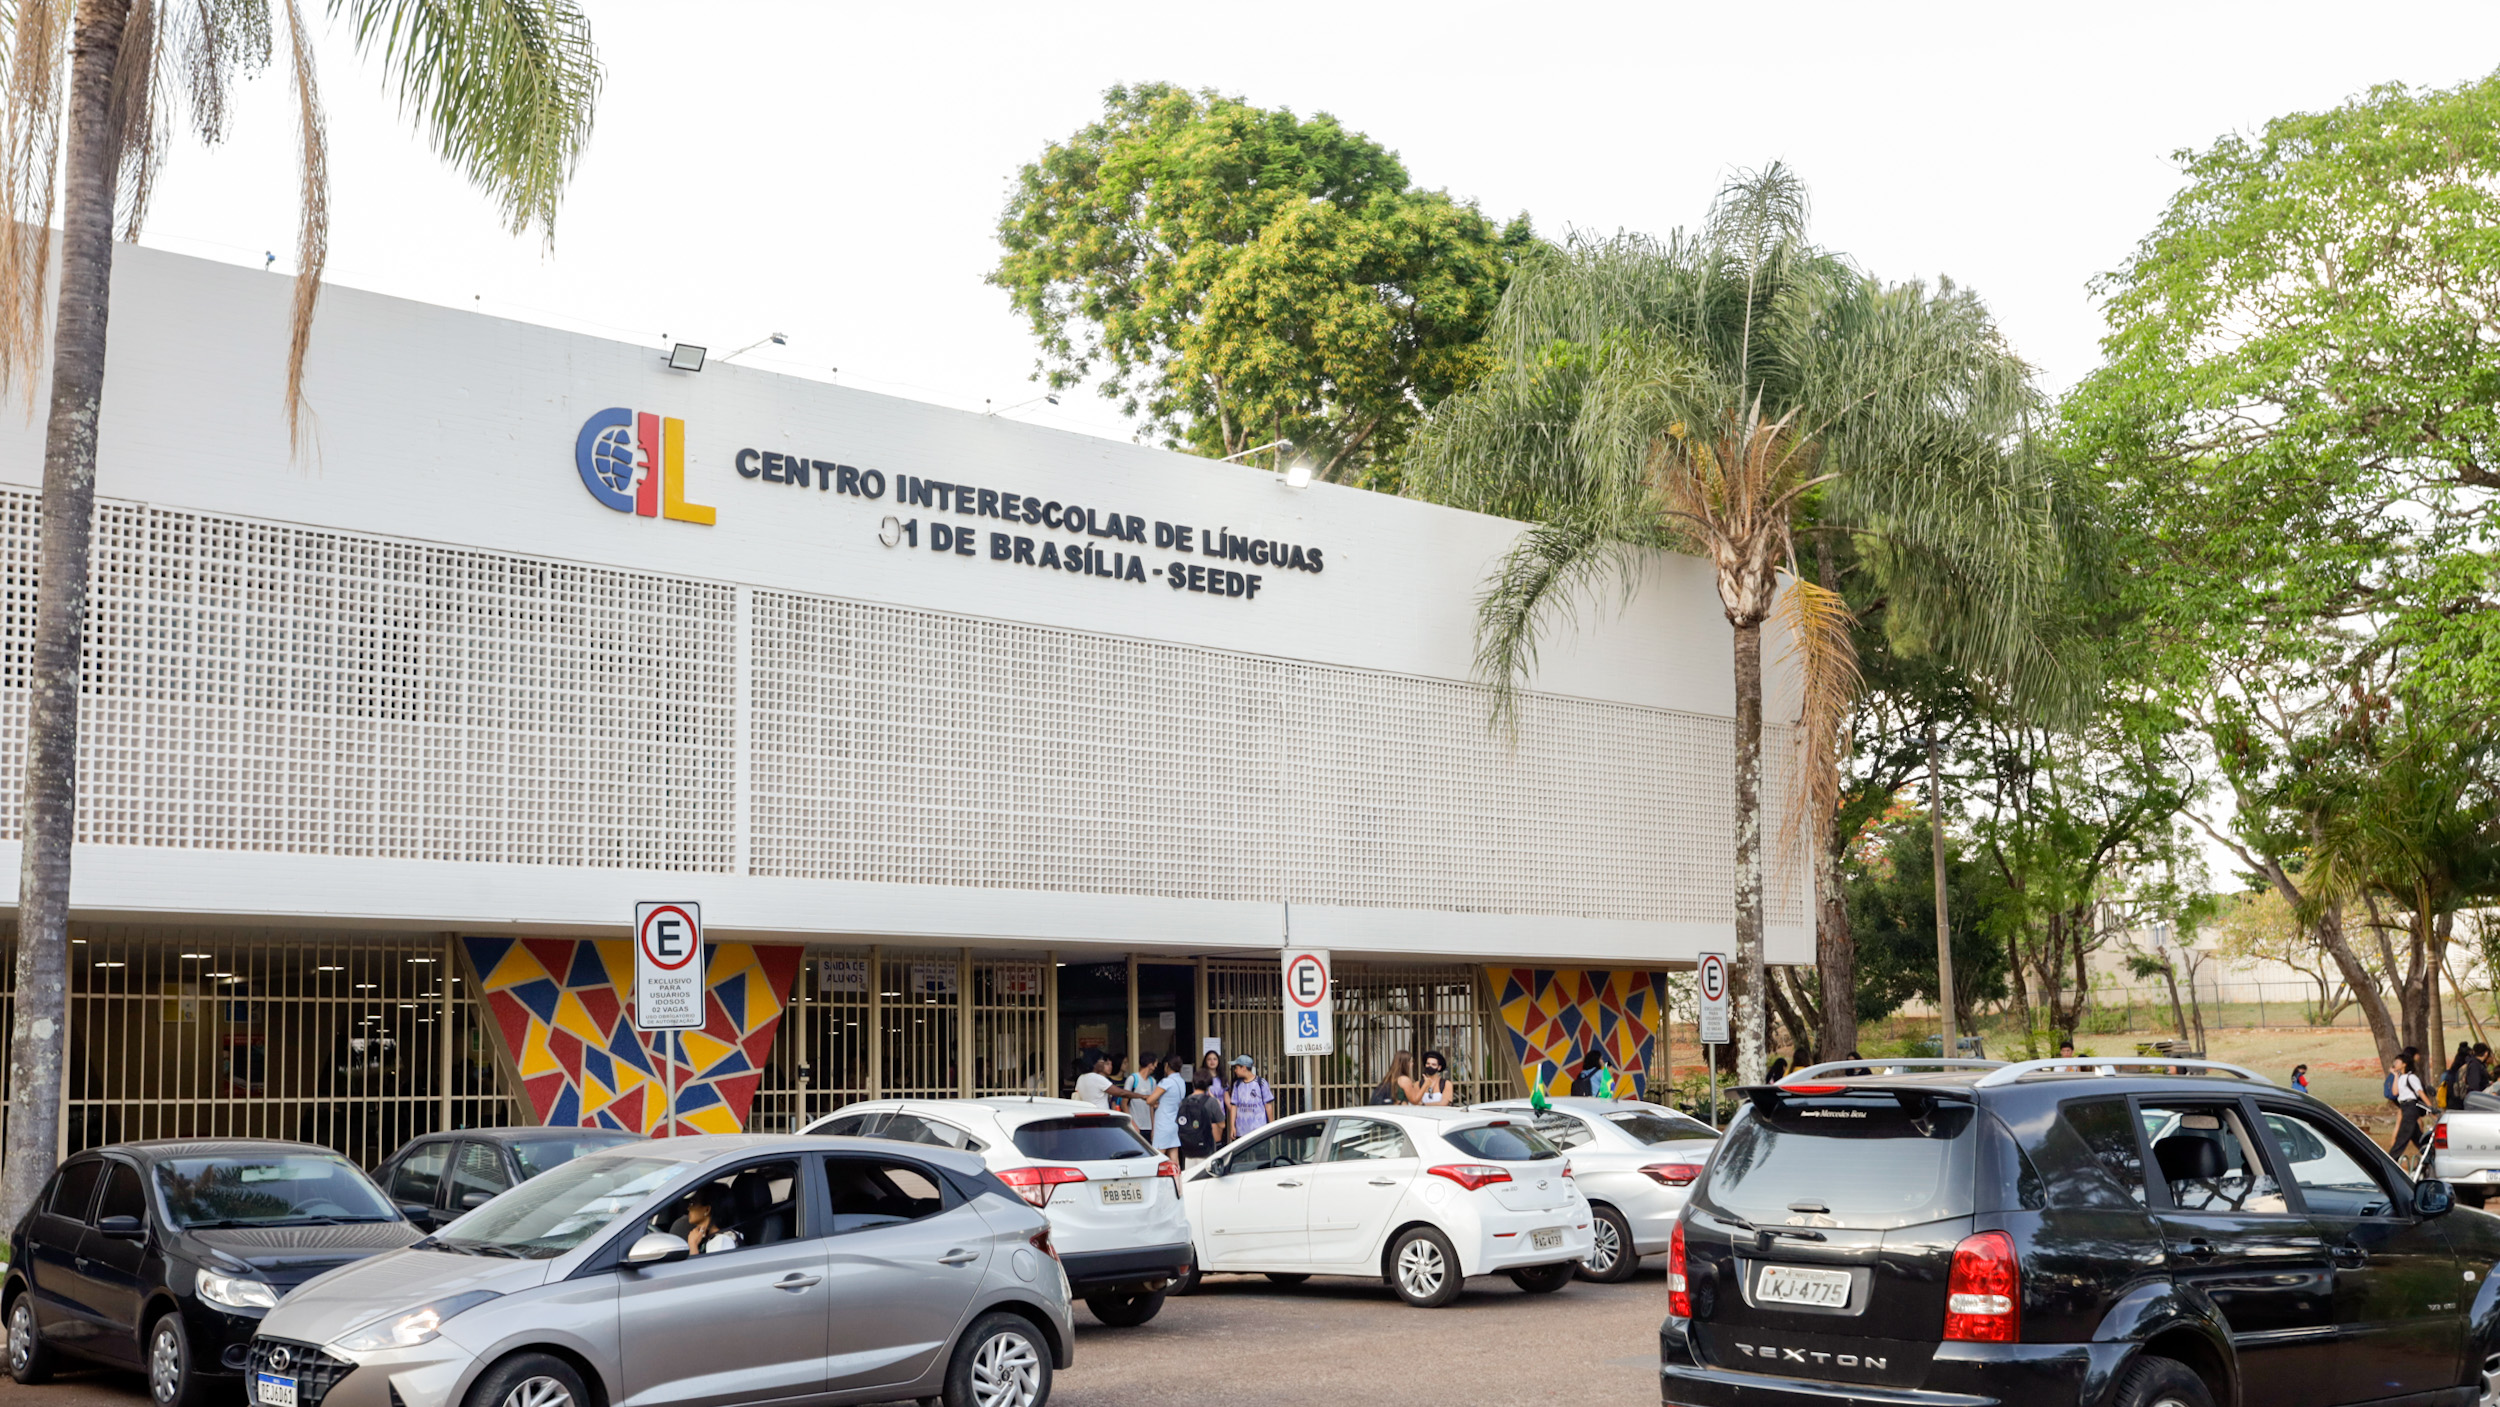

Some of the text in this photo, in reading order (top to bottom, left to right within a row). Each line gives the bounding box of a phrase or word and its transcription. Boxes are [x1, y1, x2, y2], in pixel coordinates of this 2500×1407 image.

[575, 407, 716, 526] CIL
[735, 448, 1324, 574] CENTRO INTERESCOLAR DE LÍNGUAS
[930, 522, 976, 556] DE
[990, 532, 1147, 583] BRASÍLIA
[1167, 562, 1262, 600] SEEDF
[657, 920, 683, 956] E
[1298, 966, 1316, 996] E
[1707, 965, 1719, 991] E
[650, 991, 691, 999] USUÁRIOS
[1296, 1044, 1303, 1052] 02
[1735, 1342, 1887, 1370] REXTON
